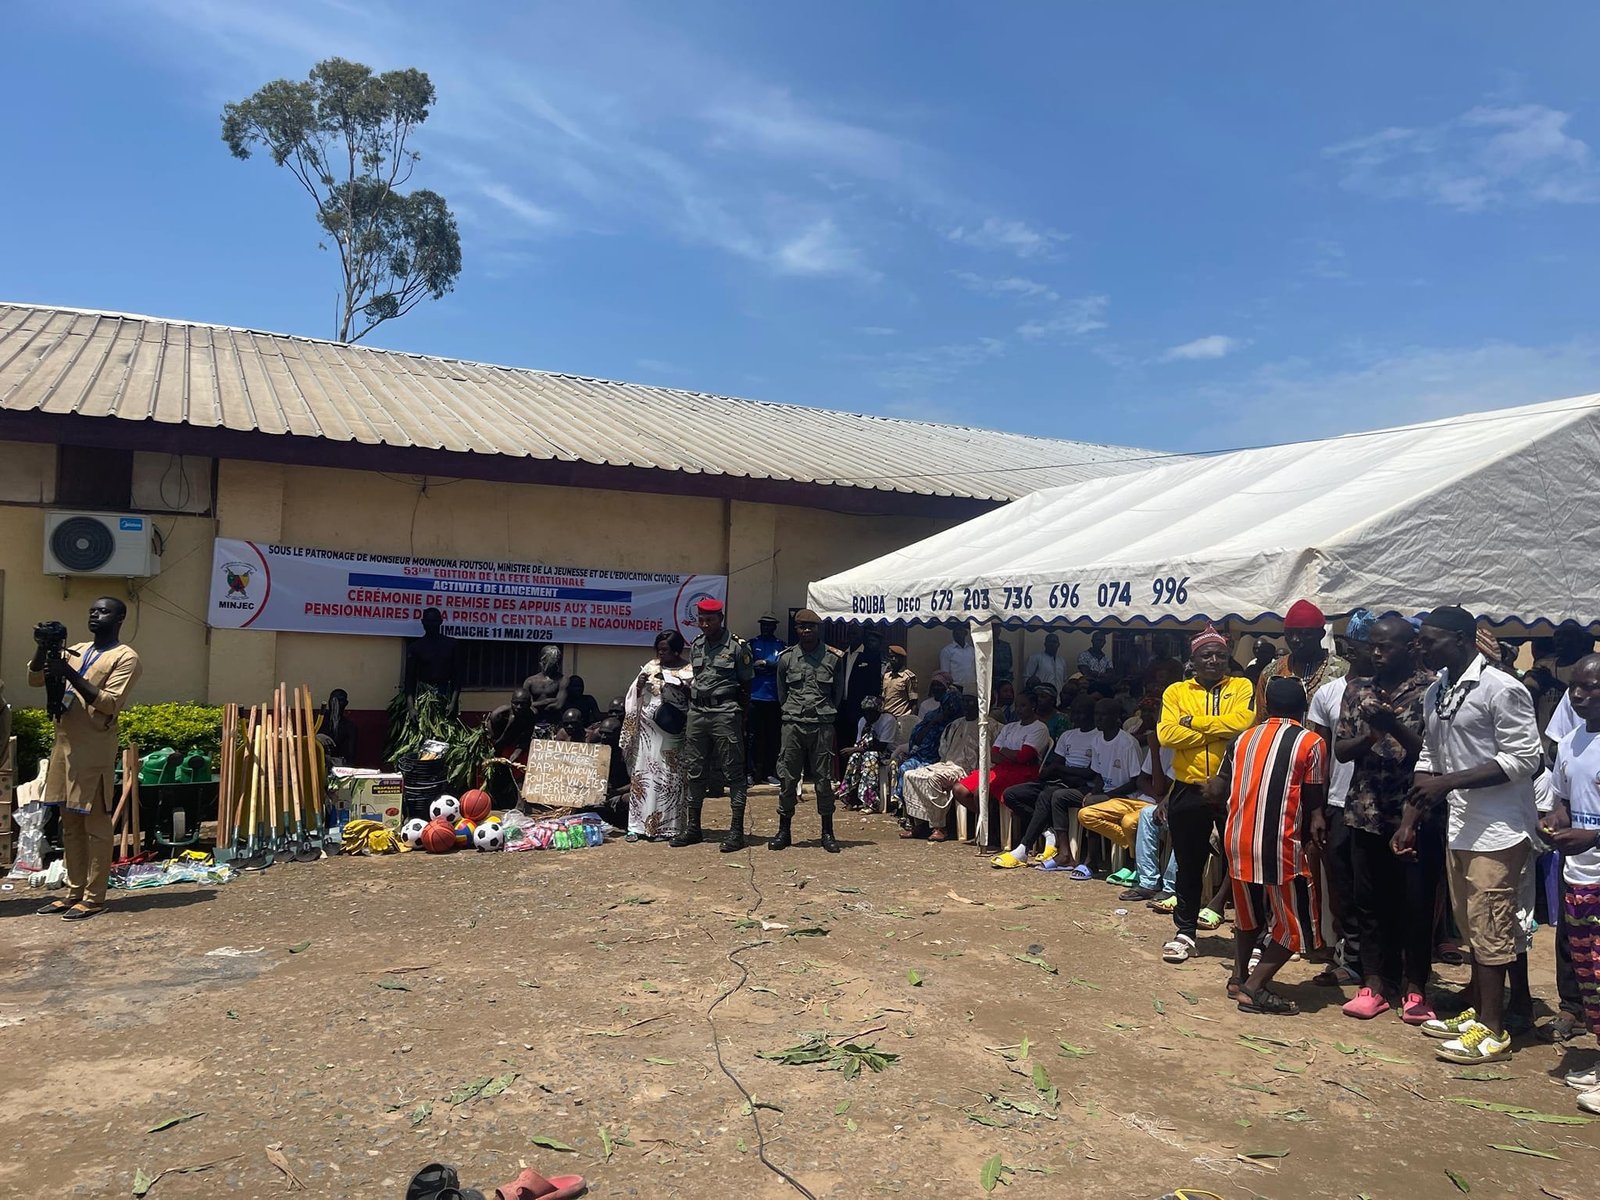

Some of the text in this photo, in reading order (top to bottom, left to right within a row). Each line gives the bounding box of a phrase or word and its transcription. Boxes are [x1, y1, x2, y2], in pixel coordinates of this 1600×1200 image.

[269, 544, 291, 556] SOUS
[293, 547, 303, 557] LE
[305, 548, 354, 561] PATRONAGE
[356, 553, 367, 561] DE
[370, 554, 410, 565] MONSIEUR
[460, 560, 495, 572] FOUTSOU,
[497, 563, 530, 574] MINISTRE
[532, 565, 541, 574] DE
[543, 566, 553, 575] LA
[554, 567, 587, 578] JEUNESSE
[589, 569, 598, 578] ET
[600, 570, 608, 579] DE
[654, 574, 680, 584] CIVIQUE
[479, 571, 490, 581] DE
[494, 573, 505, 582] LA
[532, 575, 585, 587] NATIONALE
[433, 580, 558, 598] ACTIVITE DE LANCEMENT
[853, 577, 1190, 613] BOUBA DECO 679 203 736 696 074 996
[219, 601, 255, 610] MINJEC
[348, 587, 632, 616] CÉRÉMONIE DE REMISE DES APPUIS AUX JEUNES
[304, 603, 409, 620] PENSIONNAIRES
[452, 611, 497, 625] PRISON
[501, 613, 567, 627] CENTRALE
[571, 616, 586, 628] DE
[590, 617, 663, 631] NGAOUNDÉRÉ
[441, 625, 553, 640] IMANCHE 11 MAI 2025
[533, 740, 600, 758] BIENVENUE
